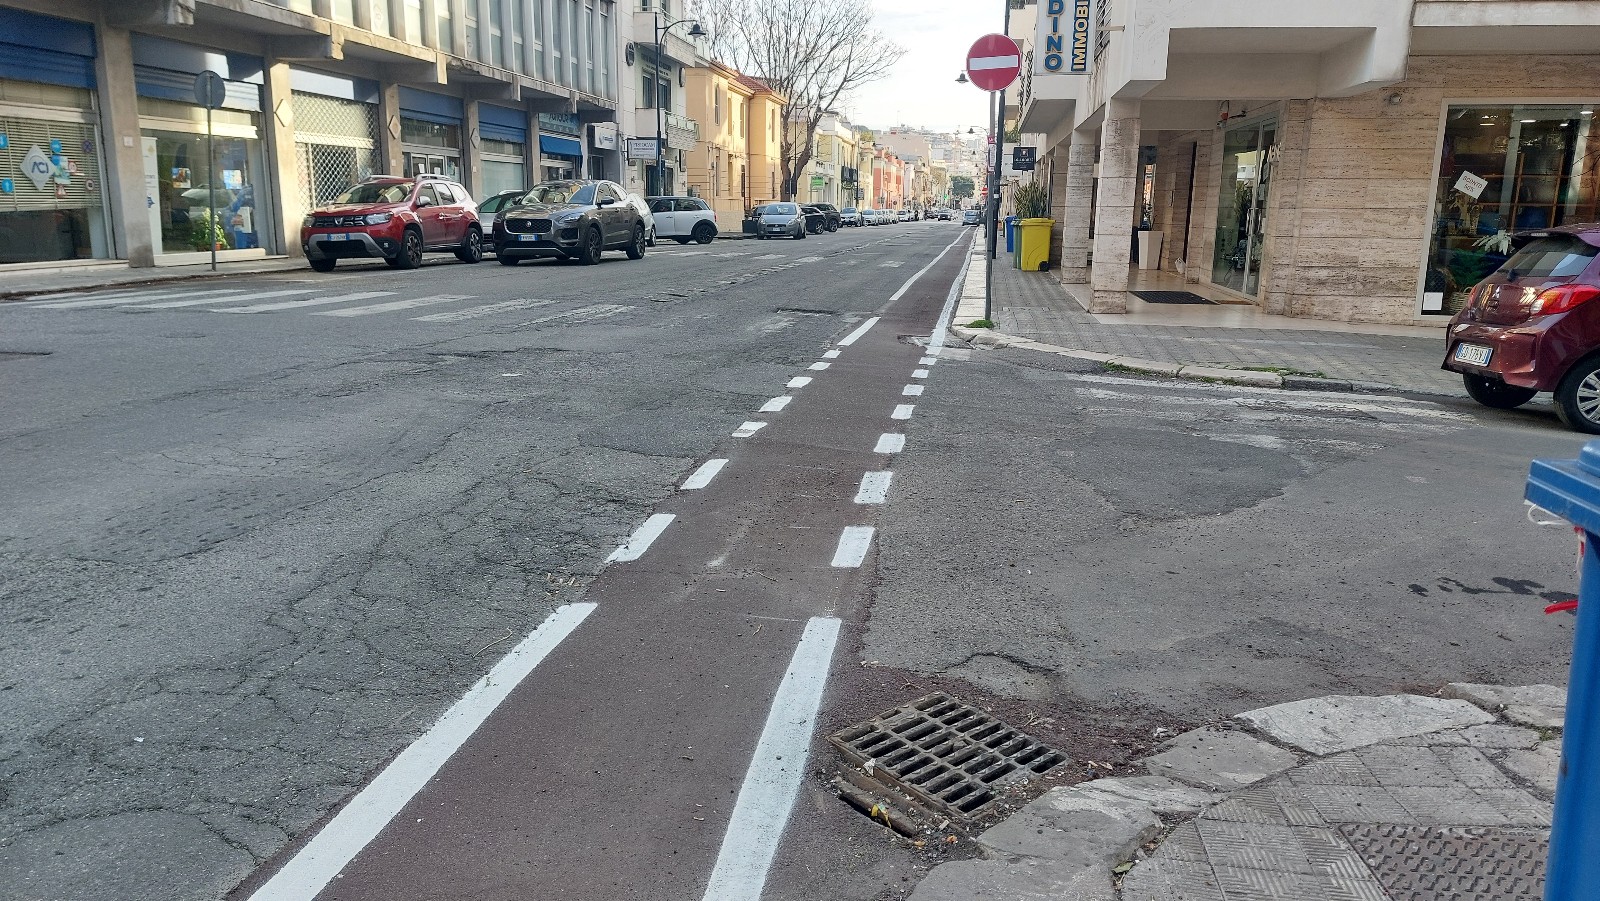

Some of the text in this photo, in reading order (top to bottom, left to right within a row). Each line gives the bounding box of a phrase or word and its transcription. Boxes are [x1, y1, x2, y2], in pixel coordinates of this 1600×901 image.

[1044, 0, 1064, 72] DINO
[1072, 0, 1089, 70] IMMOBI
[31, 161, 49, 174] ACI
